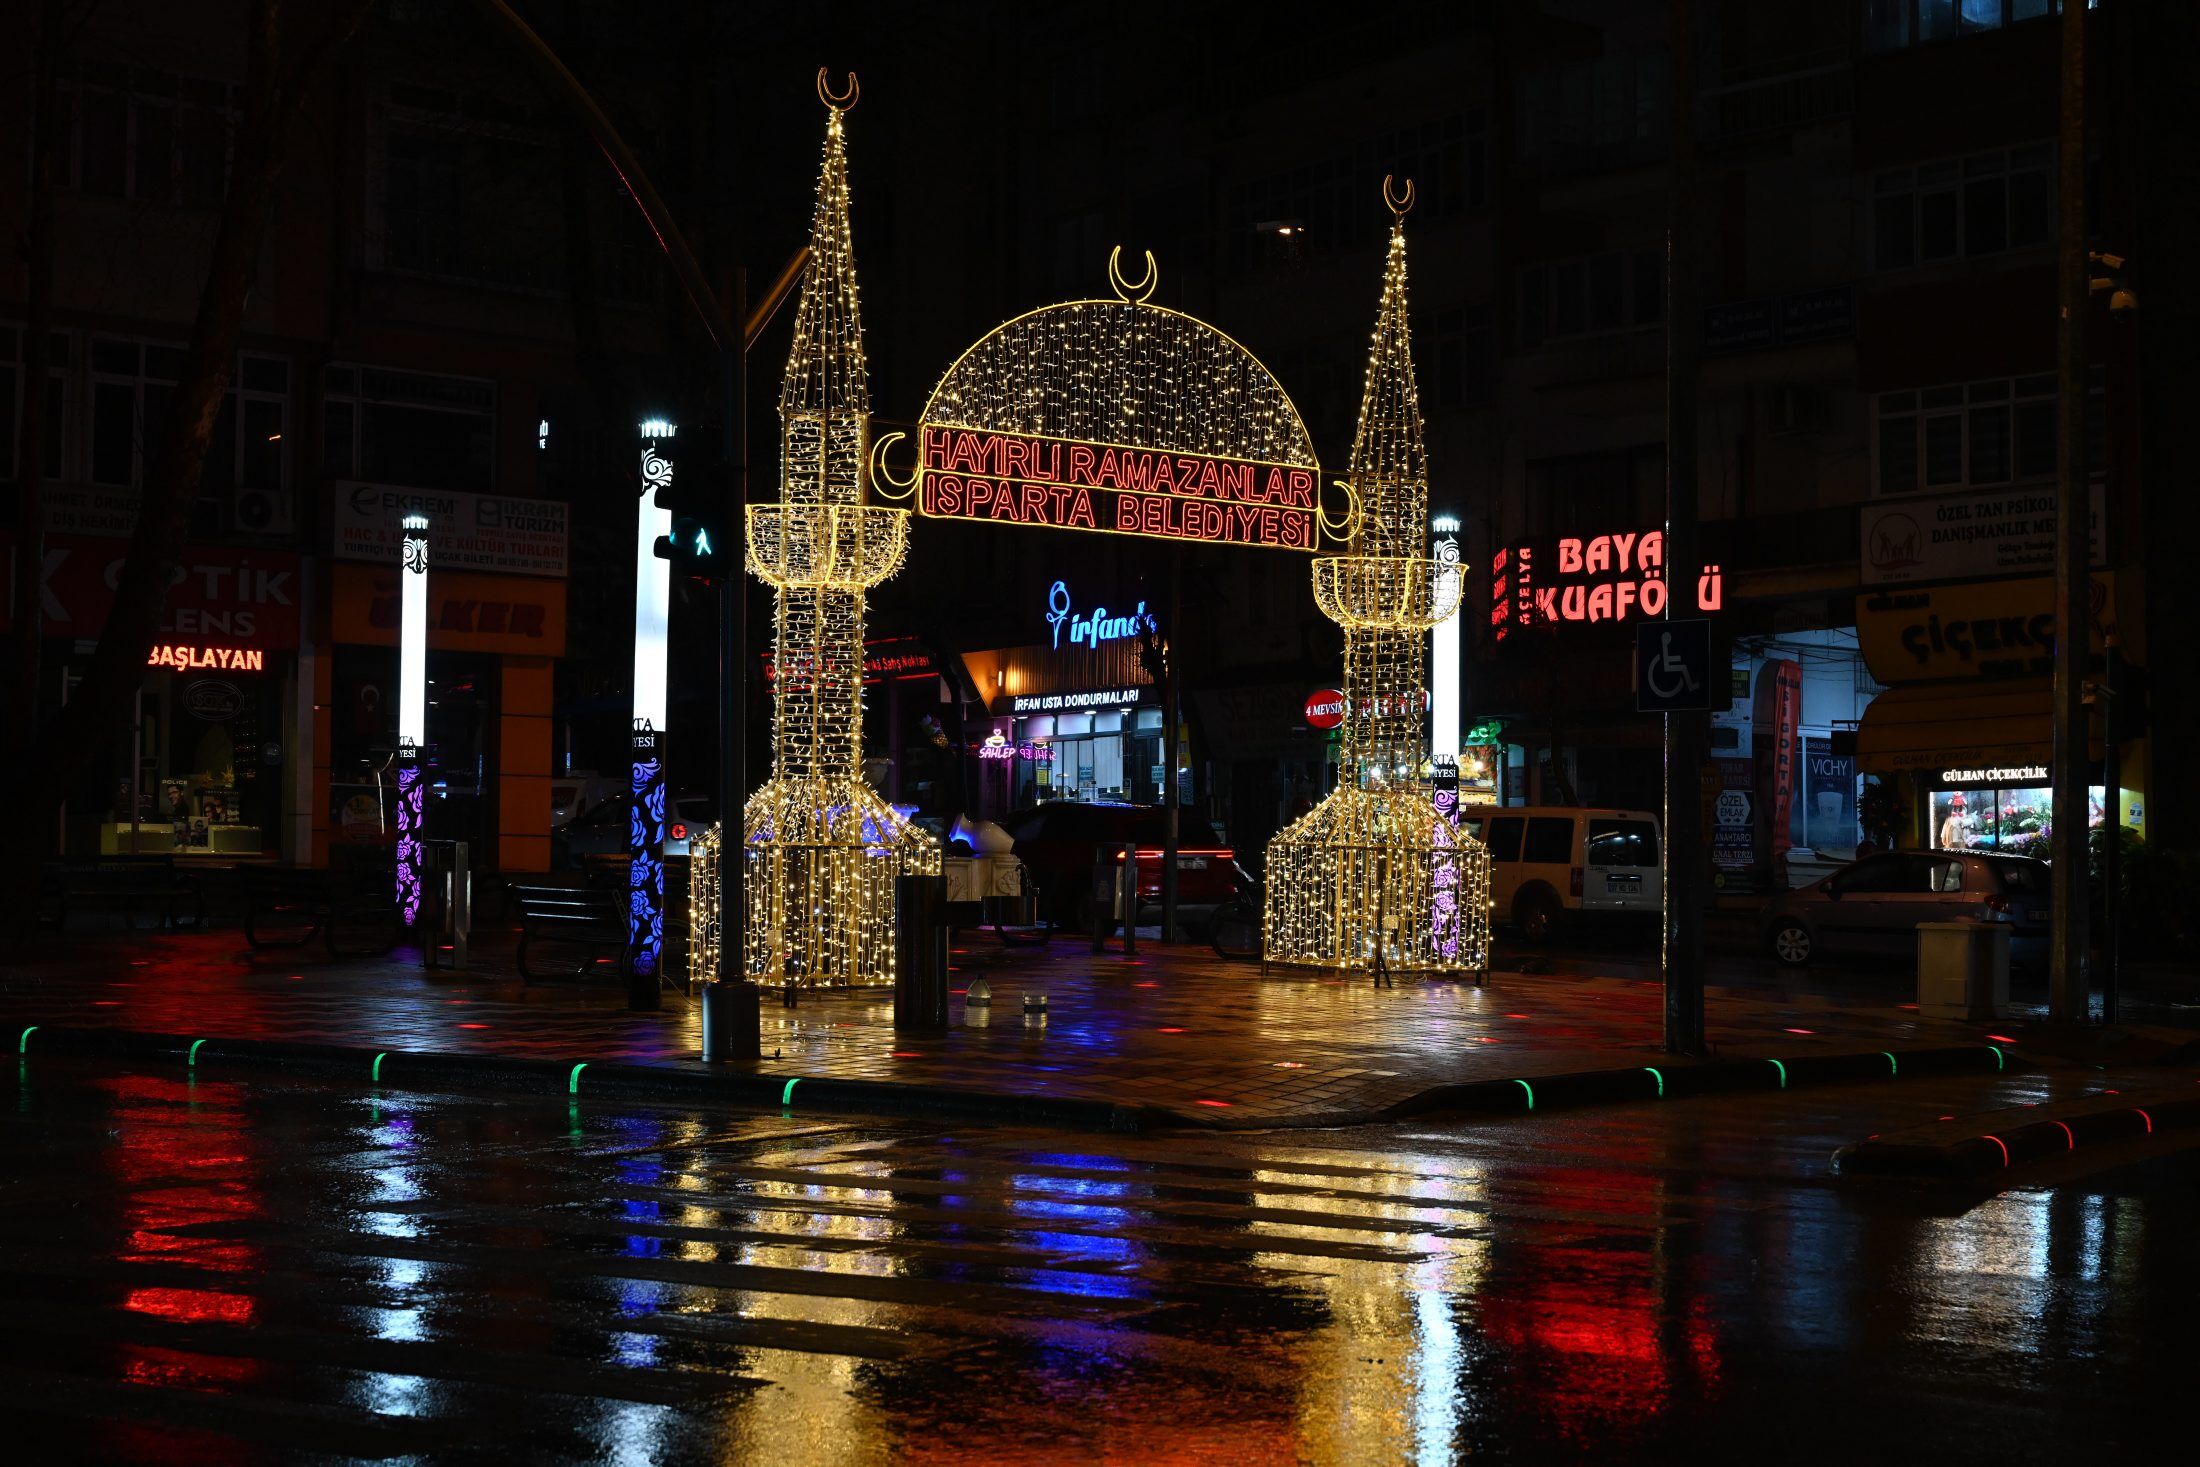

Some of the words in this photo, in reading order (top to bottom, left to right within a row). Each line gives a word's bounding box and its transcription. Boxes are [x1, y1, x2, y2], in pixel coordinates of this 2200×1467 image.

[926, 429, 1061, 482] HAYIRLI
[1070, 446, 1313, 508] RAMAZANLAR
[382, 493, 454, 514] EKREM
[926, 474, 1096, 529] ISPARTA
[1936, 504, 1972, 521] ÖZEL
[1975, 502, 2003, 518] TAN
[1932, 521, 2029, 544] DANIŞMANLIK
[436, 535, 453, 549] VE
[456, 535, 505, 553] KÜLTÜR
[510, 542, 564, 558] TURLARI
[1558, 530, 1664, 575] BAYA
[1535, 564, 1723, 624] KUAFÖÜ
[1902, 613, 2056, 664] ÇİÇEKÇ
[1014, 696, 1041, 711] İRFAN
[1042, 695, 1063, 709] USTA
[1065, 689, 1139, 708] DONDURMALARI
[1305, 704, 1312, 716] 4
[979, 747, 1016, 759] SAHLEP
[1811, 758, 1848, 777] VICHY
[1942, 769, 1984, 782] GÜLHAN
[1986, 765, 2048, 782] ÇİÇEKÇİLİK
[1720, 793, 1744, 807] ÖZEL
[1720, 808, 1744, 817] EMLAK
[1714, 833, 1752, 842] ANAHTARCI
